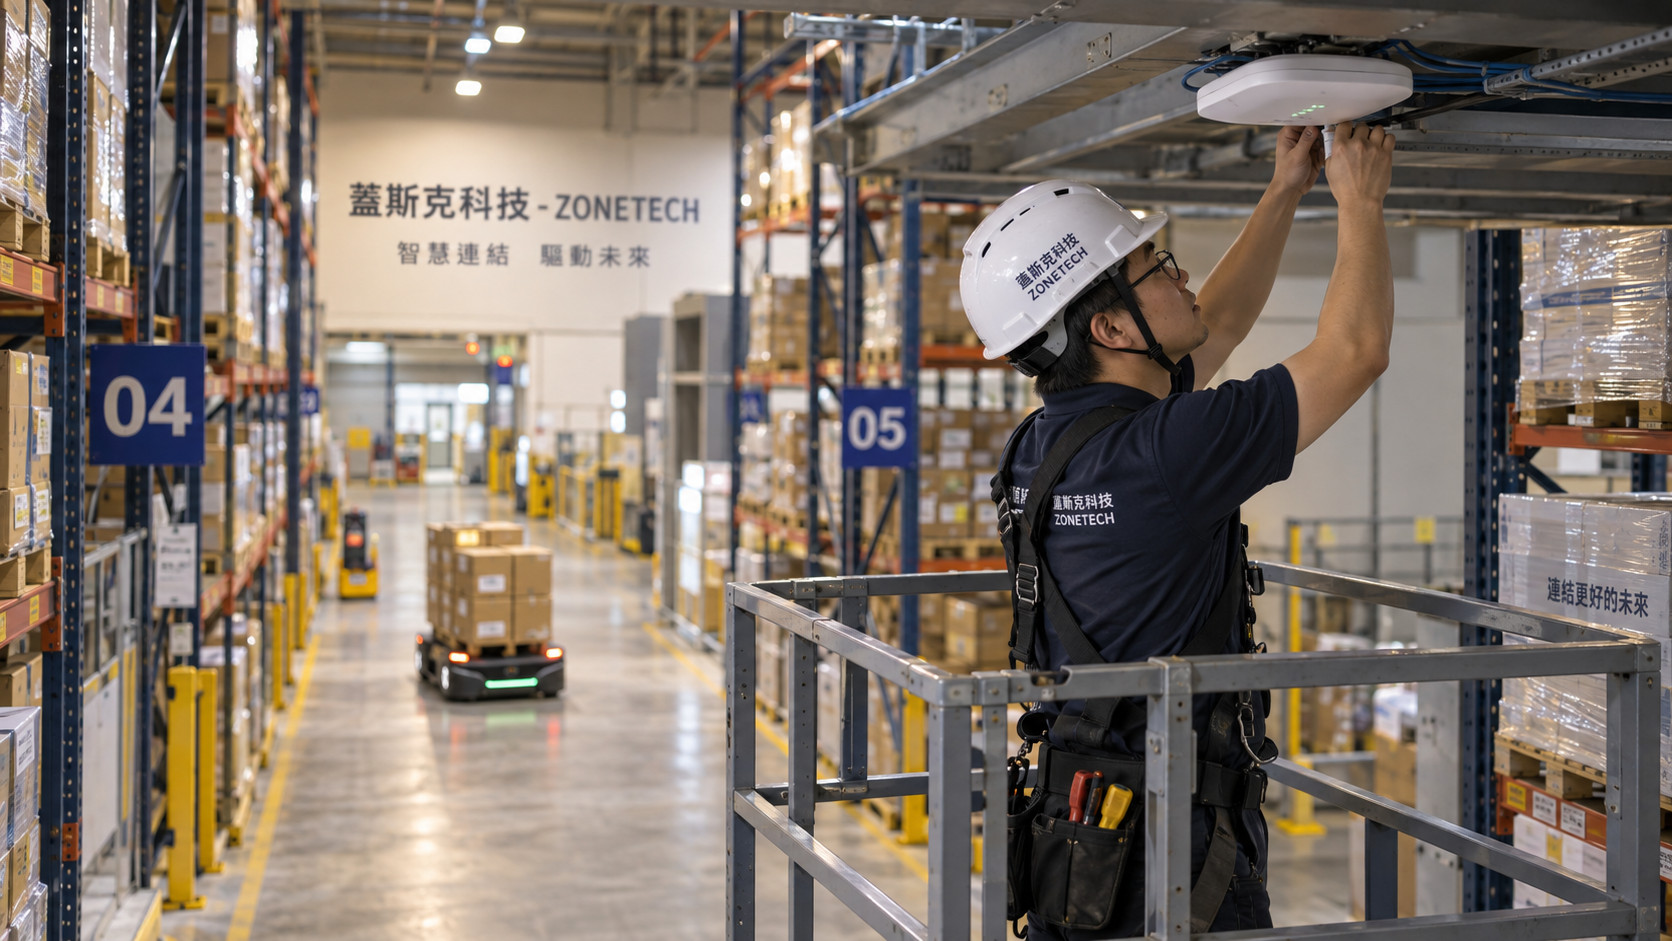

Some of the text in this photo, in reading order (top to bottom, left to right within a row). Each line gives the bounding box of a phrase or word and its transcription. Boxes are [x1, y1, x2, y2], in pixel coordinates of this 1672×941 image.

[349, 182, 530, 221] 蓋斯克科技
[555, 193, 700, 223] ZONETECH
[397, 241, 650, 268] 智慧連結 驅動未來
[1028, 246, 1088, 301] ZONETECH
[104, 375, 192, 437] 04
[848, 406, 906, 450] 05
[1054, 512, 1115, 526] ZONETECH
[1547, 577, 1649, 618] 連結更好的未來
